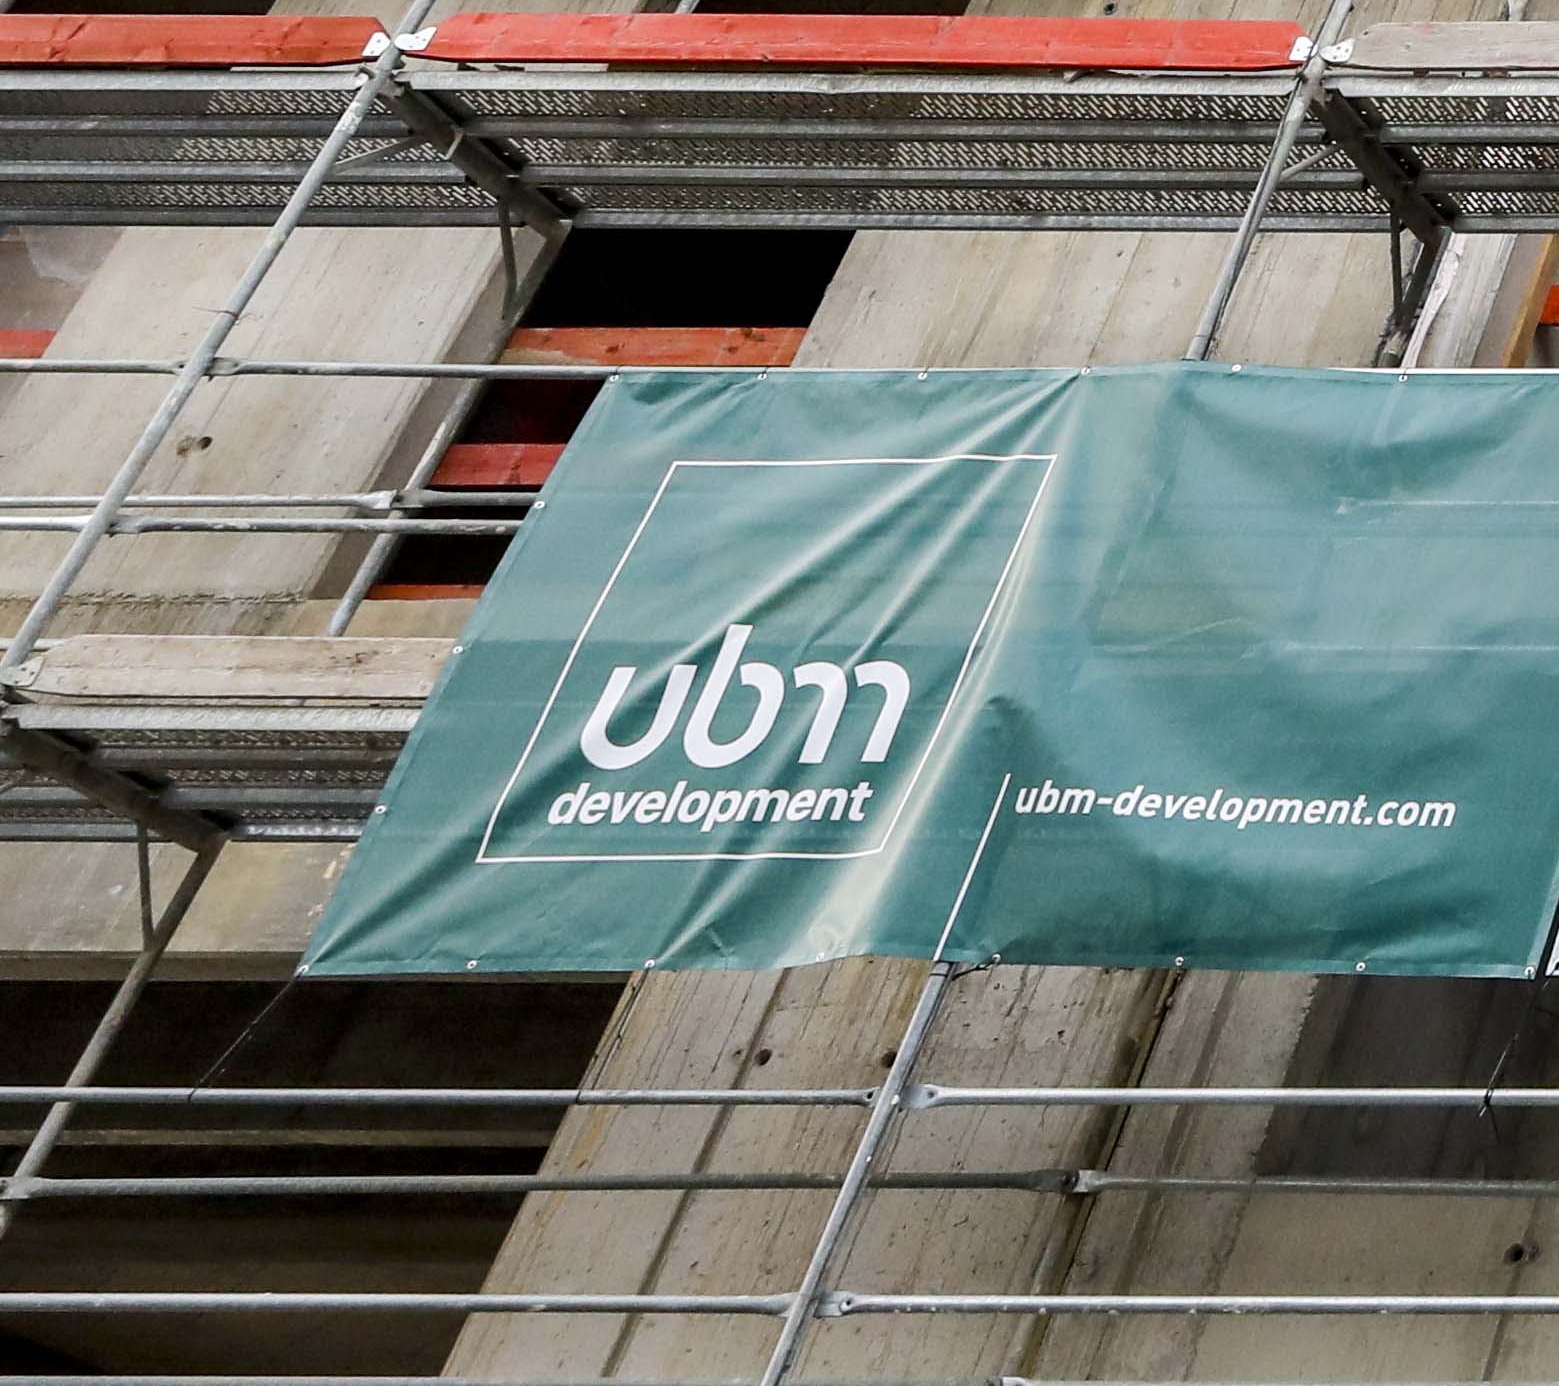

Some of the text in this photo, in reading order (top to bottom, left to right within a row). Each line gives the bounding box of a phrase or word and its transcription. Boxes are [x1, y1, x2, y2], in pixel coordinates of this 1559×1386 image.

[580, 624, 911, 770] ubm
[547, 780, 874, 833] development
[1014, 779, 1457, 830] ubm-development.com
